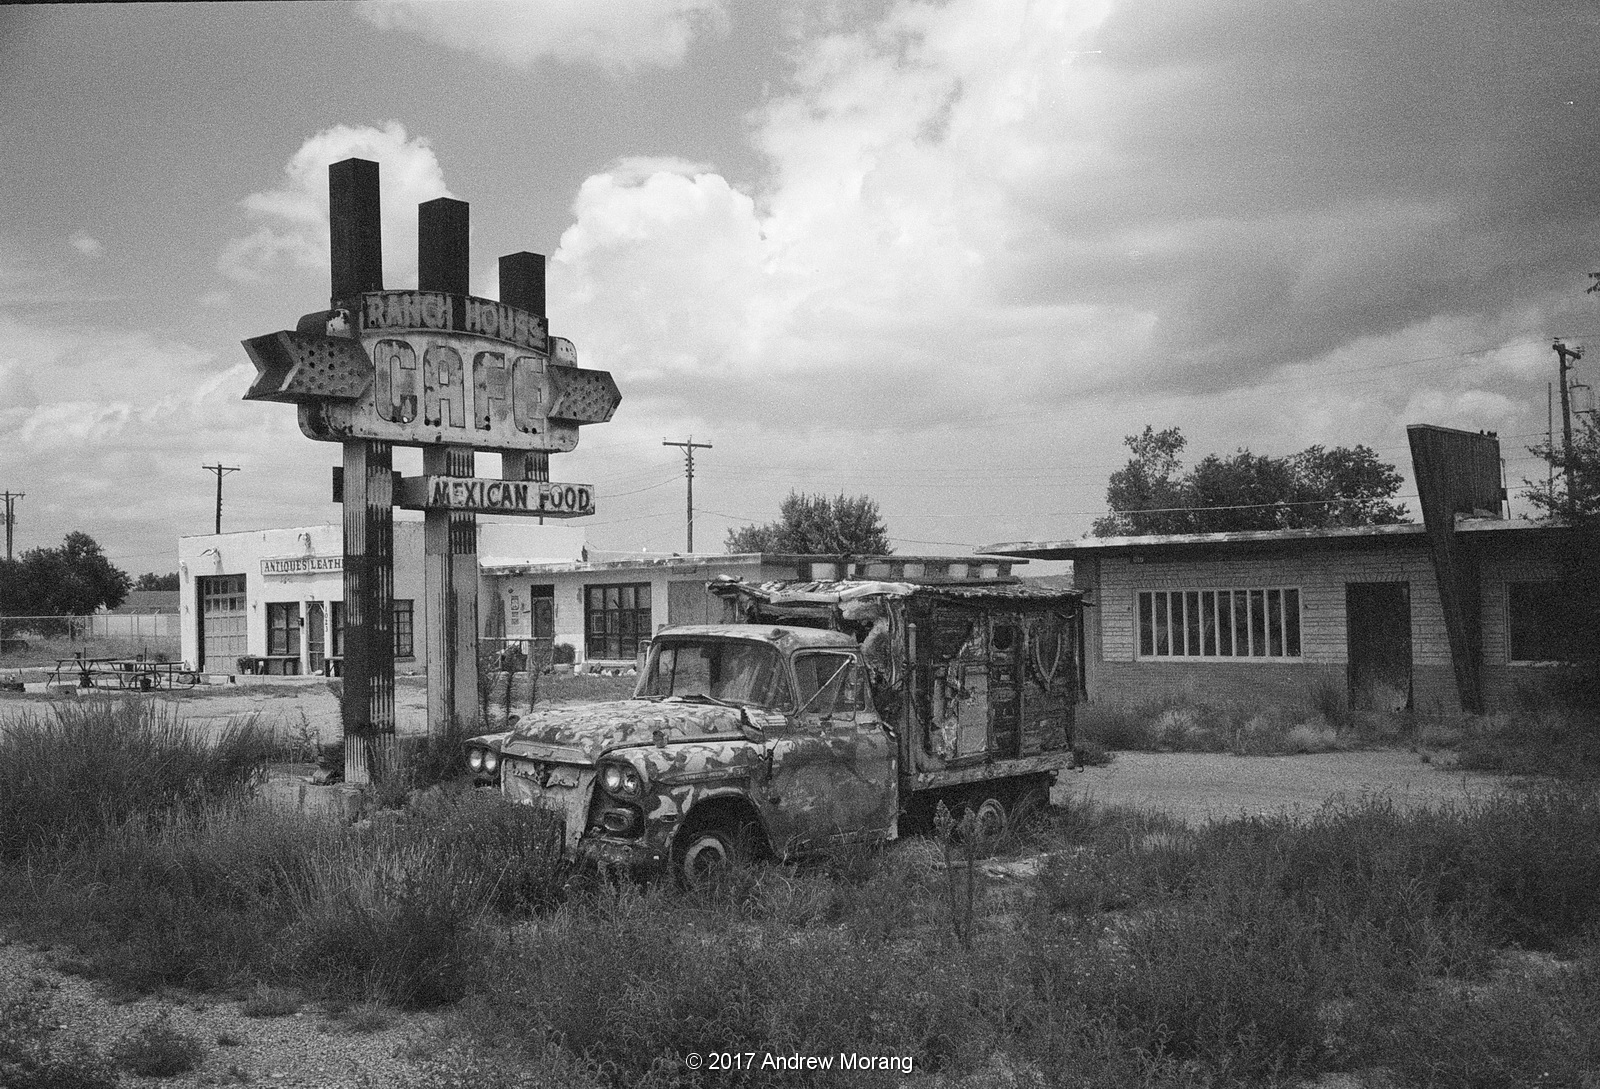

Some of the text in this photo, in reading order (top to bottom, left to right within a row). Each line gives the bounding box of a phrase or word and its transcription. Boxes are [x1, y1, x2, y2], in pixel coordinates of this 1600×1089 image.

[366, 292, 453, 328] RANCH
[373, 338, 545, 435] CAFE
[432, 480, 591, 513] MEXICAN FOOD
[264, 559, 344, 572] ANTIQUES LEATH
